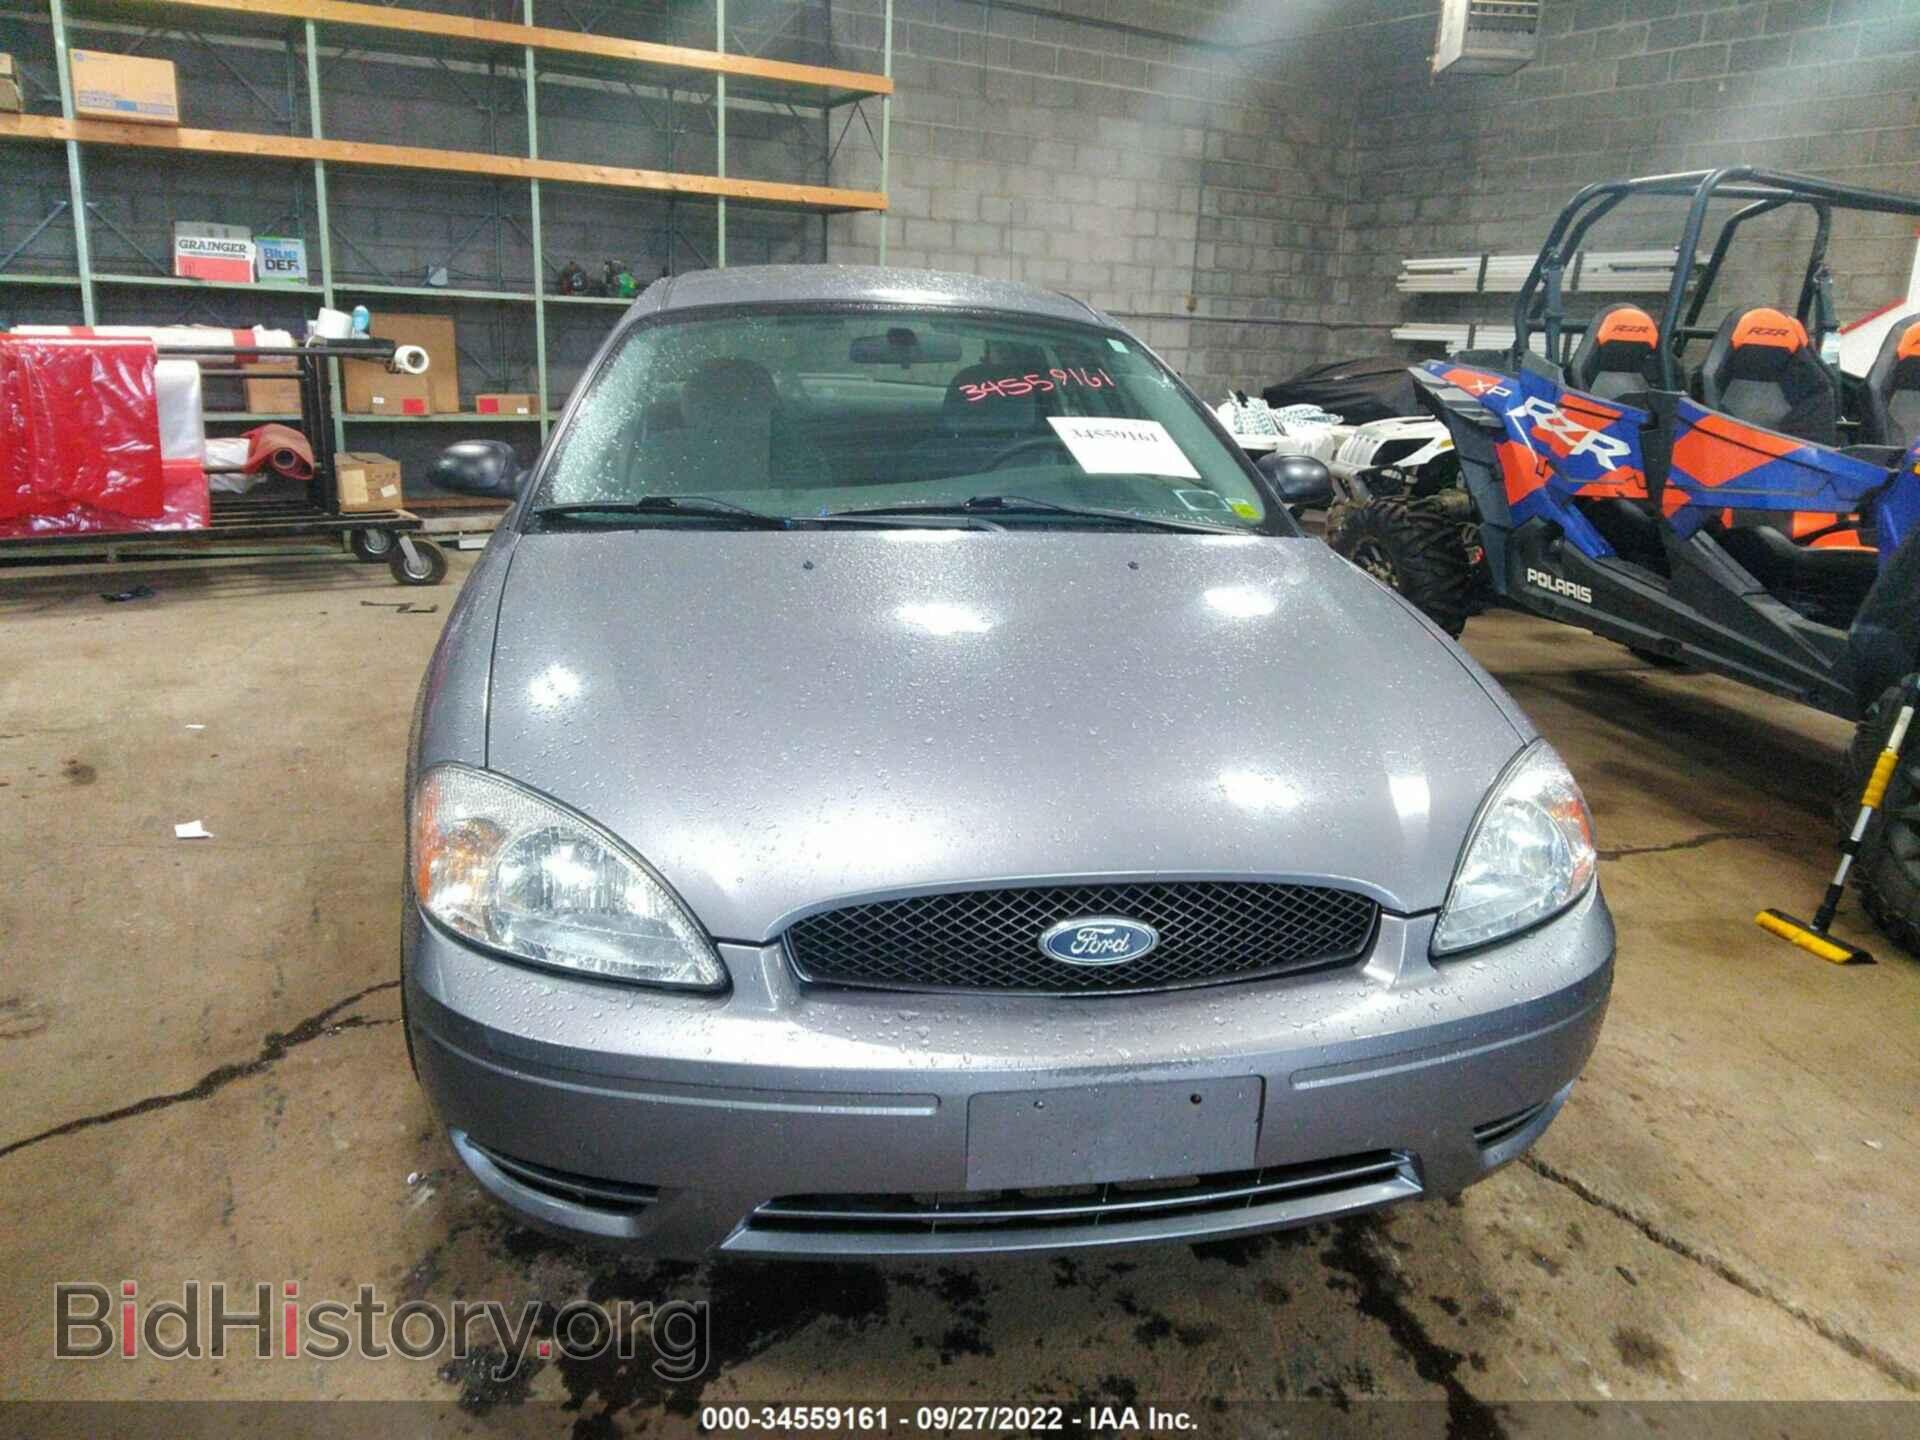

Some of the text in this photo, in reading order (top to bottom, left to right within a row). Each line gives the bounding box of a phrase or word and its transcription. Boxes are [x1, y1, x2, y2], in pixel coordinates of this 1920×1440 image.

[179, 239, 247, 254] GRAINGER
[264, 247, 297, 259] Blue
[1611, 323, 1650, 334] RZR
[1747, 327, 1789, 337] RZR
[959, 368, 1115, 402] 34559161
[1469, 380, 1512, 397] XP
[1072, 428, 1159, 443] 34559161
[1505, 396, 1632, 472] RZR
[1527, 567, 1592, 604] POLARIS
[1070, 927, 1131, 954] Ford
